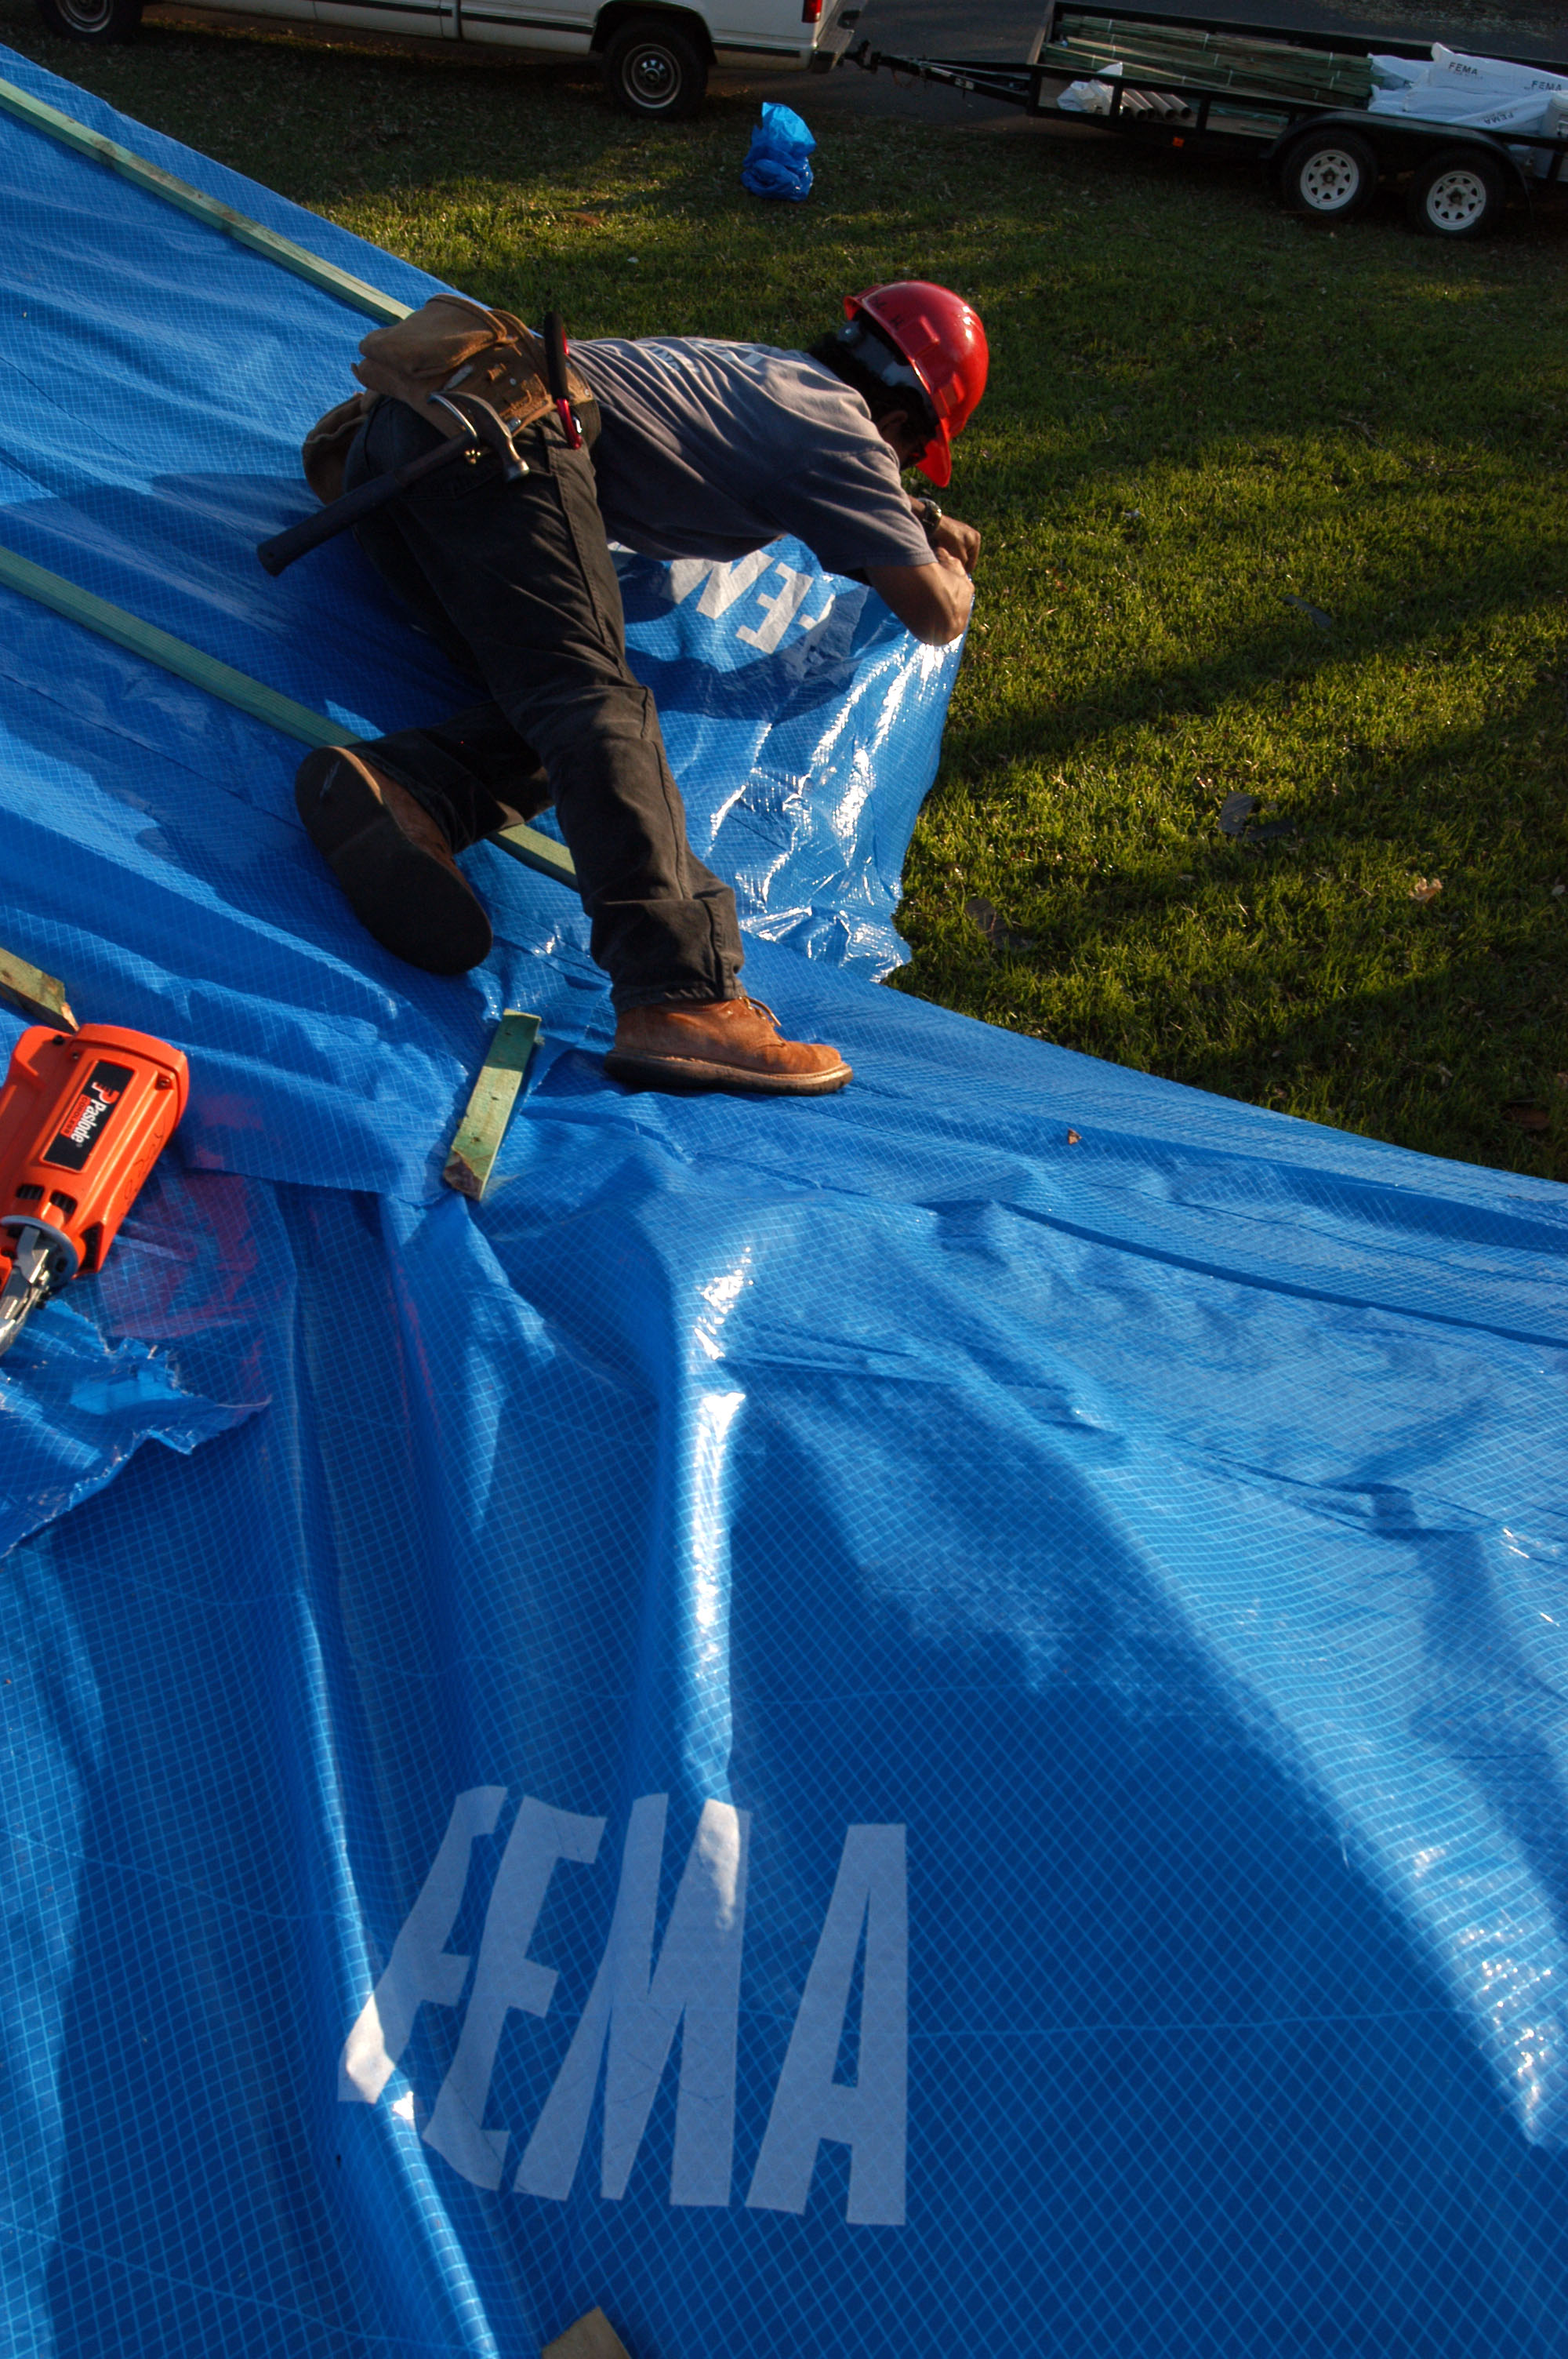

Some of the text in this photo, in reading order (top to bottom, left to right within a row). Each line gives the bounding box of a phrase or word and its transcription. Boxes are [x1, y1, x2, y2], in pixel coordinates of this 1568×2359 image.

[1449, 62, 1478, 75] FEMA
[1530, 80, 1562, 91] FEMA
[1484, 111, 1514, 124] FEMA
[608, 541, 870, 691] FEM
[71, 1099, 107, 1143] Paslode
[338, 1786, 907, 2226] FEMA
